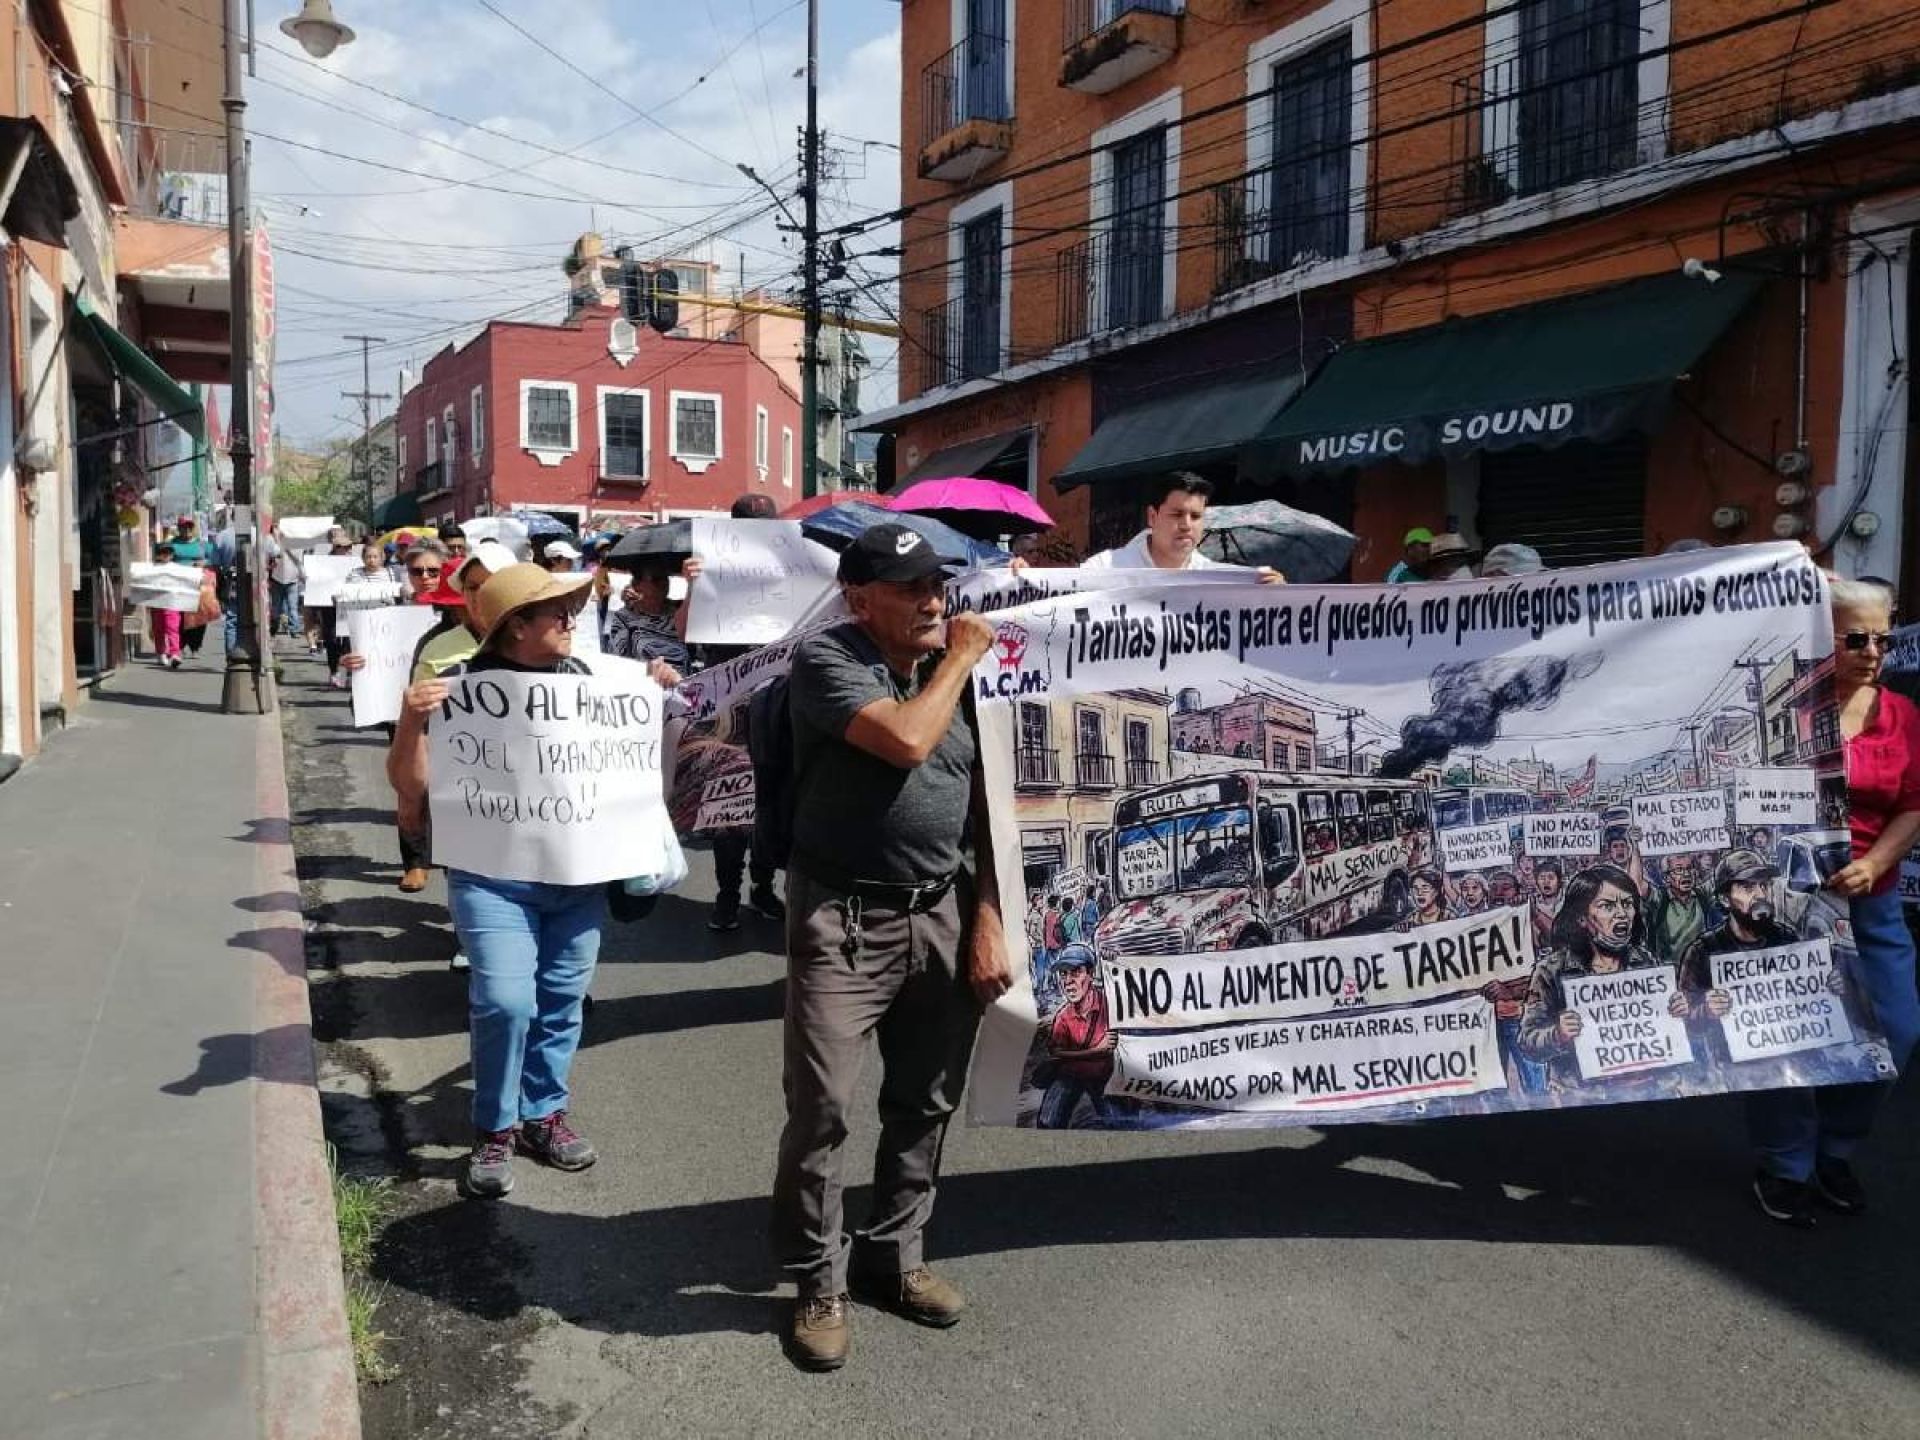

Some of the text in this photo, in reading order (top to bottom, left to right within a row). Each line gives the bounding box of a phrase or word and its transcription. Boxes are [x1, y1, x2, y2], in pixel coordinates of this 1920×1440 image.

[1300, 402, 1574, 464] MUSIC SOUND
[1066, 561, 1822, 679] ¡Tarifas justas para el pueblo, no privilegios para unos cuantos!
[979, 669, 1048, 699] A.C.M.
[441, 680, 510, 721] NO
[525, 683, 568, 720] AL
[449, 731, 515, 773] DEL
[1146, 792, 1185, 815] RUTA
[1637, 797, 1720, 817] MAL ESTADO
[1759, 790, 1778, 801] UN
[1531, 820, 1556, 834] ¡NO
[1671, 817, 1687, 829] DE
[1122, 847, 1160, 862] TARIFA
[1528, 834, 1597, 851] TARIFAZOS!
[1310, 847, 1400, 896] MAL SERVICIO
[1111, 916, 1524, 1022] ¡NO AL AUMENTO DE TARIFA!
[1717, 949, 1828, 984] ¡RECHAZO AL
[1572, 975, 1668, 1007] ¡CAMIONES
[1731, 971, 1827, 1007] TARIFASO!
[1600, 1021, 1657, 1044] RUTAS
[1733, 1000, 1833, 1033] ¡QUEREMOS
[1149, 1037, 1230, 1071] ¡UNIDADES
[1235, 1027, 1289, 1052] VIEJAS
[1295, 1026, 1305, 1042] Y
[1310, 1017, 1419, 1041] CHATARRAS,
[1747, 1020, 1834, 1049] CALIDAD!
[1595, 1036, 1673, 1068] ROTAS!
[1125, 1045, 1477, 1101] ¡PAGAMOS POR MAL SERVICIO!
